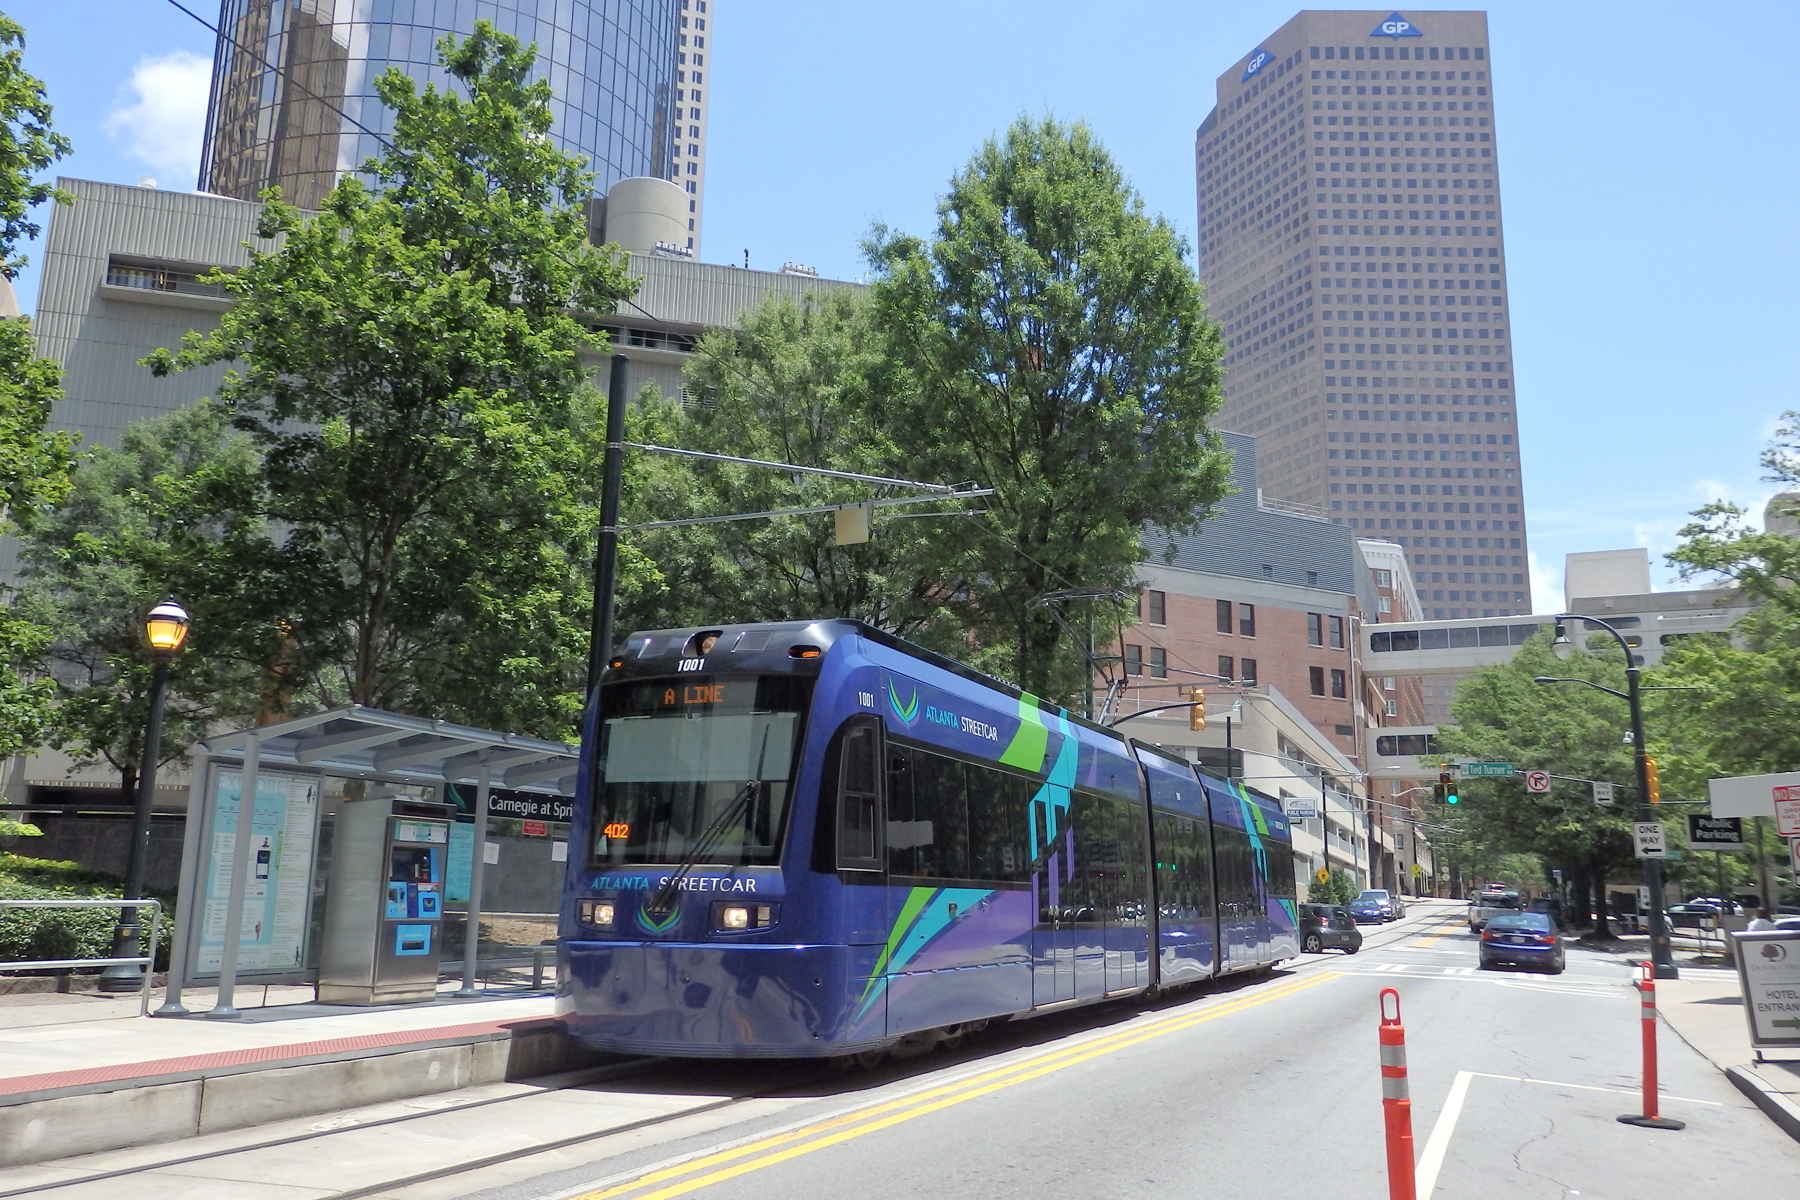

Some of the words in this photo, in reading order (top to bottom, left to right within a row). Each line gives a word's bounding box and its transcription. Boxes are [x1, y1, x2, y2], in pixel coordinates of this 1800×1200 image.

[1381, 21, 1409, 34] GP
[1247, 52, 1265, 73] GP
[677, 658, 705, 672] 1001
[664, 687, 676, 705] A
[683, 685, 725, 704] LINE
[858, 691, 874, 708] 1001
[925, 706, 959, 729] ATLANTA
[960, 716, 998, 741] STREETCAR
[488, 794, 538, 816] Carnegie
[540, 802, 551, 816] at
[603, 823, 629, 839] 402
[1638, 825, 1659, 834] ONE
[1695, 828, 1739, 842] Parking
[1640, 836, 1660, 845] WAY
[591, 876, 650, 890] ATLANTA
[1766, 990, 1800, 1000] HOTEL
